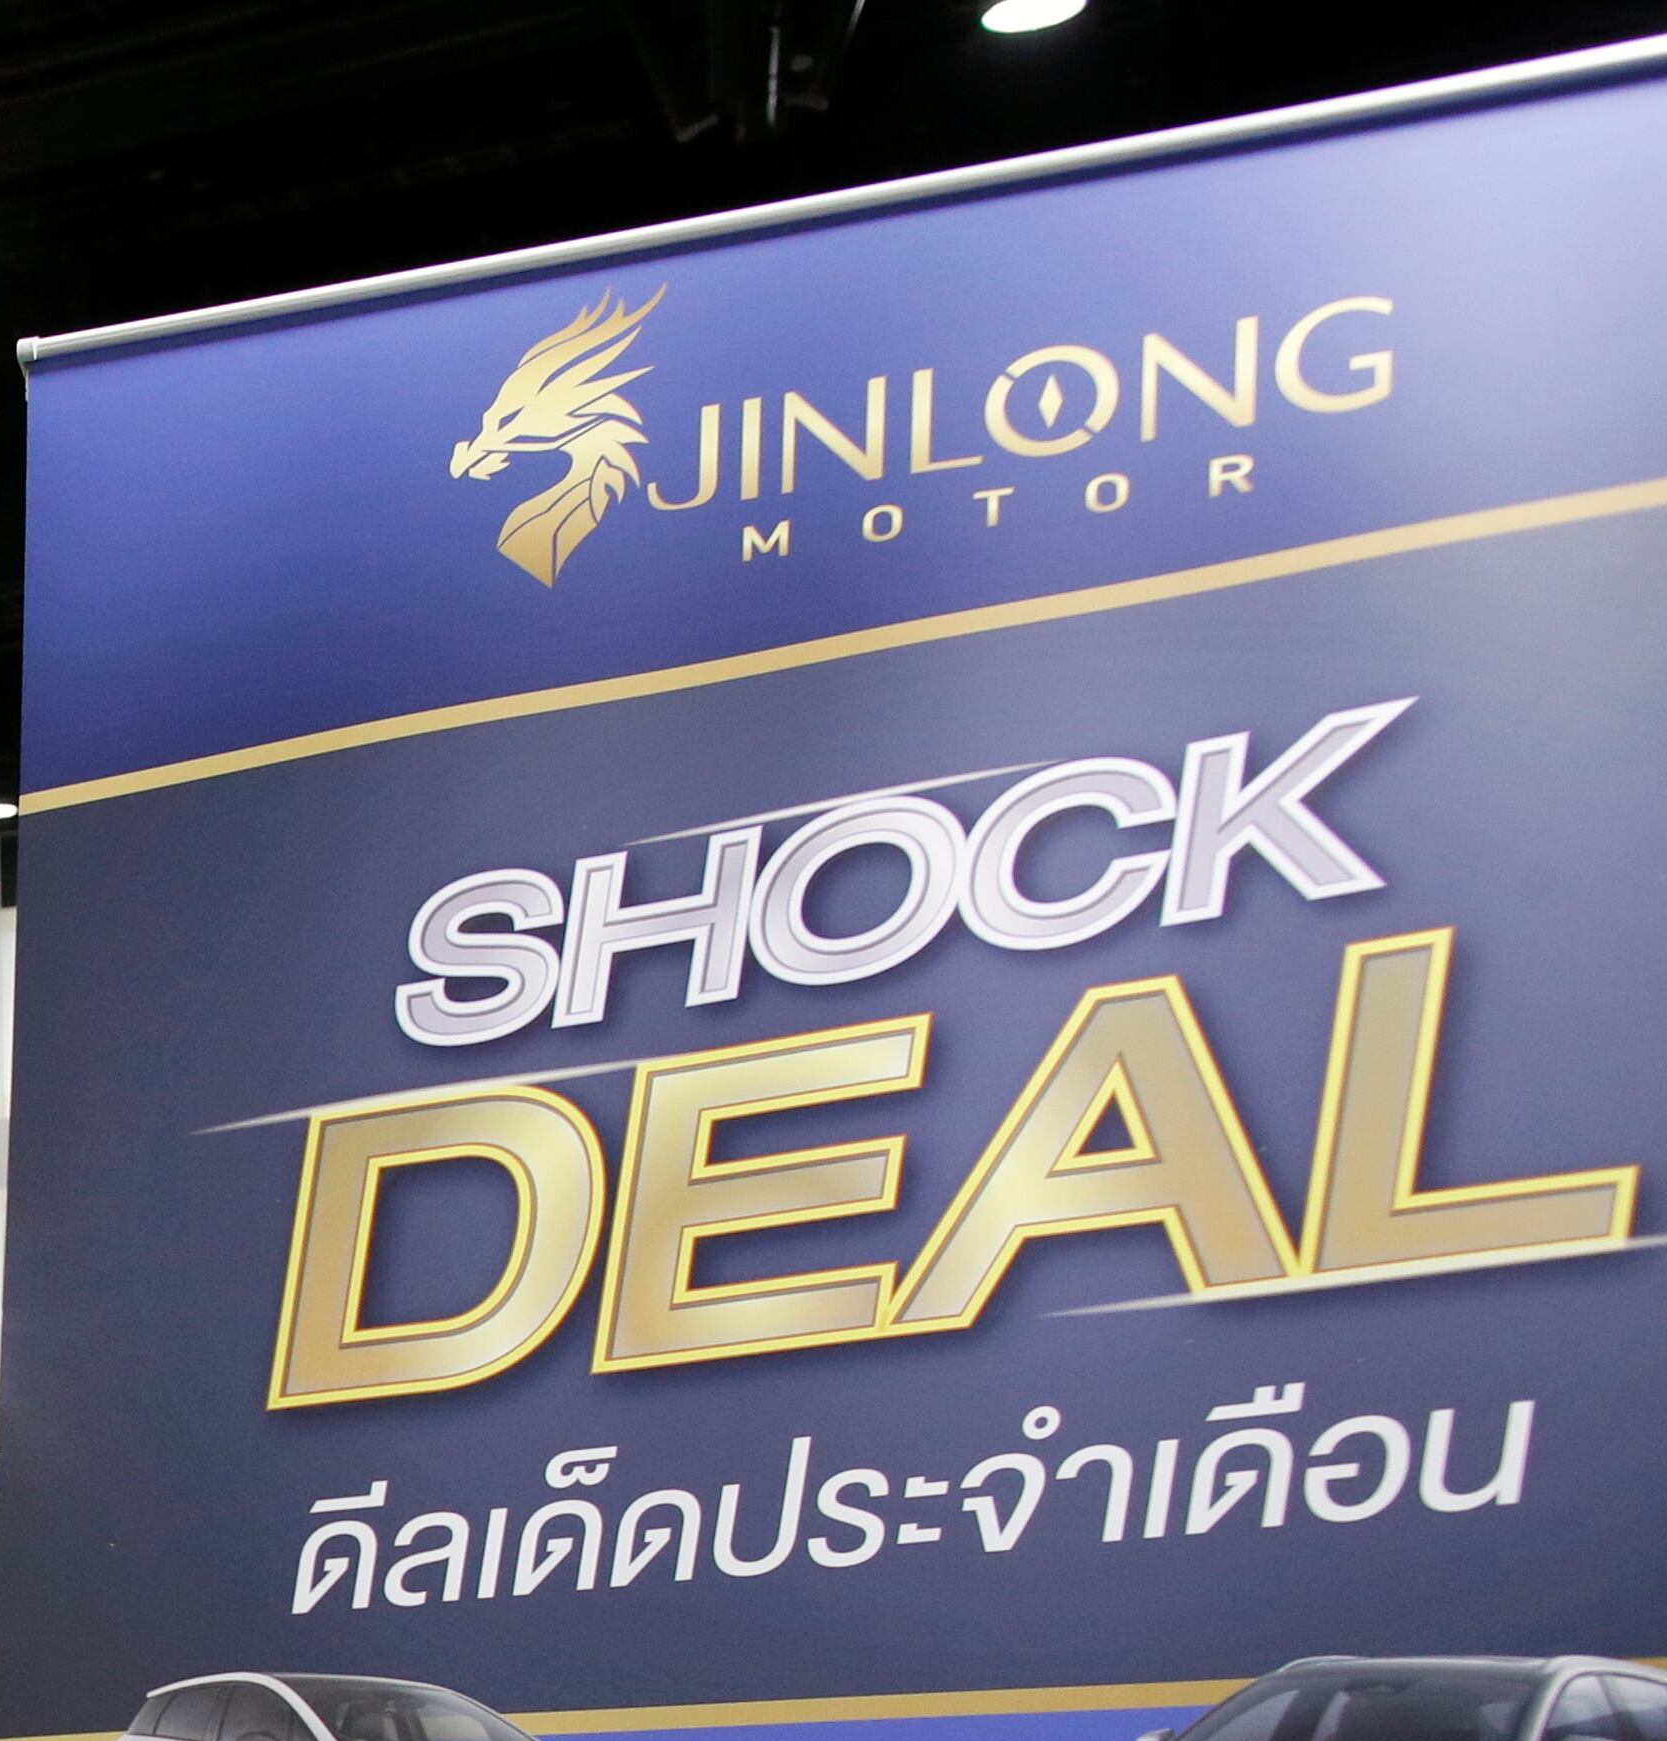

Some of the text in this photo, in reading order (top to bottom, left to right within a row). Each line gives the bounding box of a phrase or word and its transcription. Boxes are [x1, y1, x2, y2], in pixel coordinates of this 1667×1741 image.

[646, 296, 1395, 512] JINLONG
[740, 454, 1255, 562] MOTOR
[395, 697, 1419, 1047] SHOCK
[267, 925, 1639, 1411] DEAL
[290, 1381, 1537, 1615] ดีลเด็ดประจำเดือน
